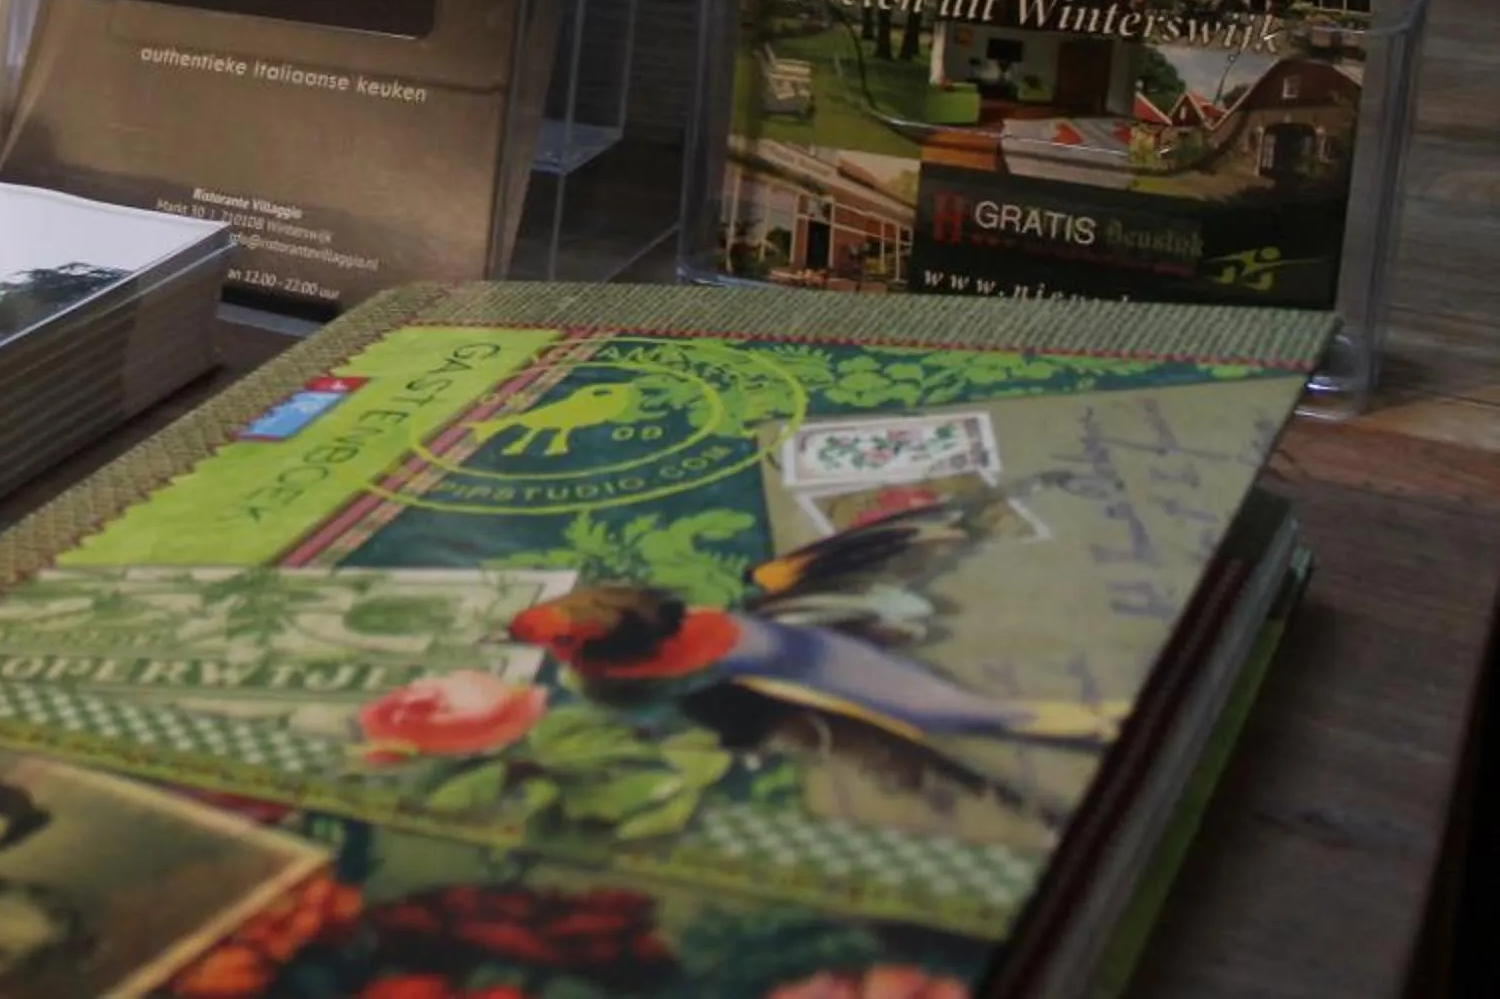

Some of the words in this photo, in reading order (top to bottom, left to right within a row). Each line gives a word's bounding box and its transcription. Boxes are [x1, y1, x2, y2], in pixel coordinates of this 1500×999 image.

[140, 47, 247, 76] authentieke
[357, 75, 427, 103] keuken
[974, 200, 1097, 245] GRATIS
